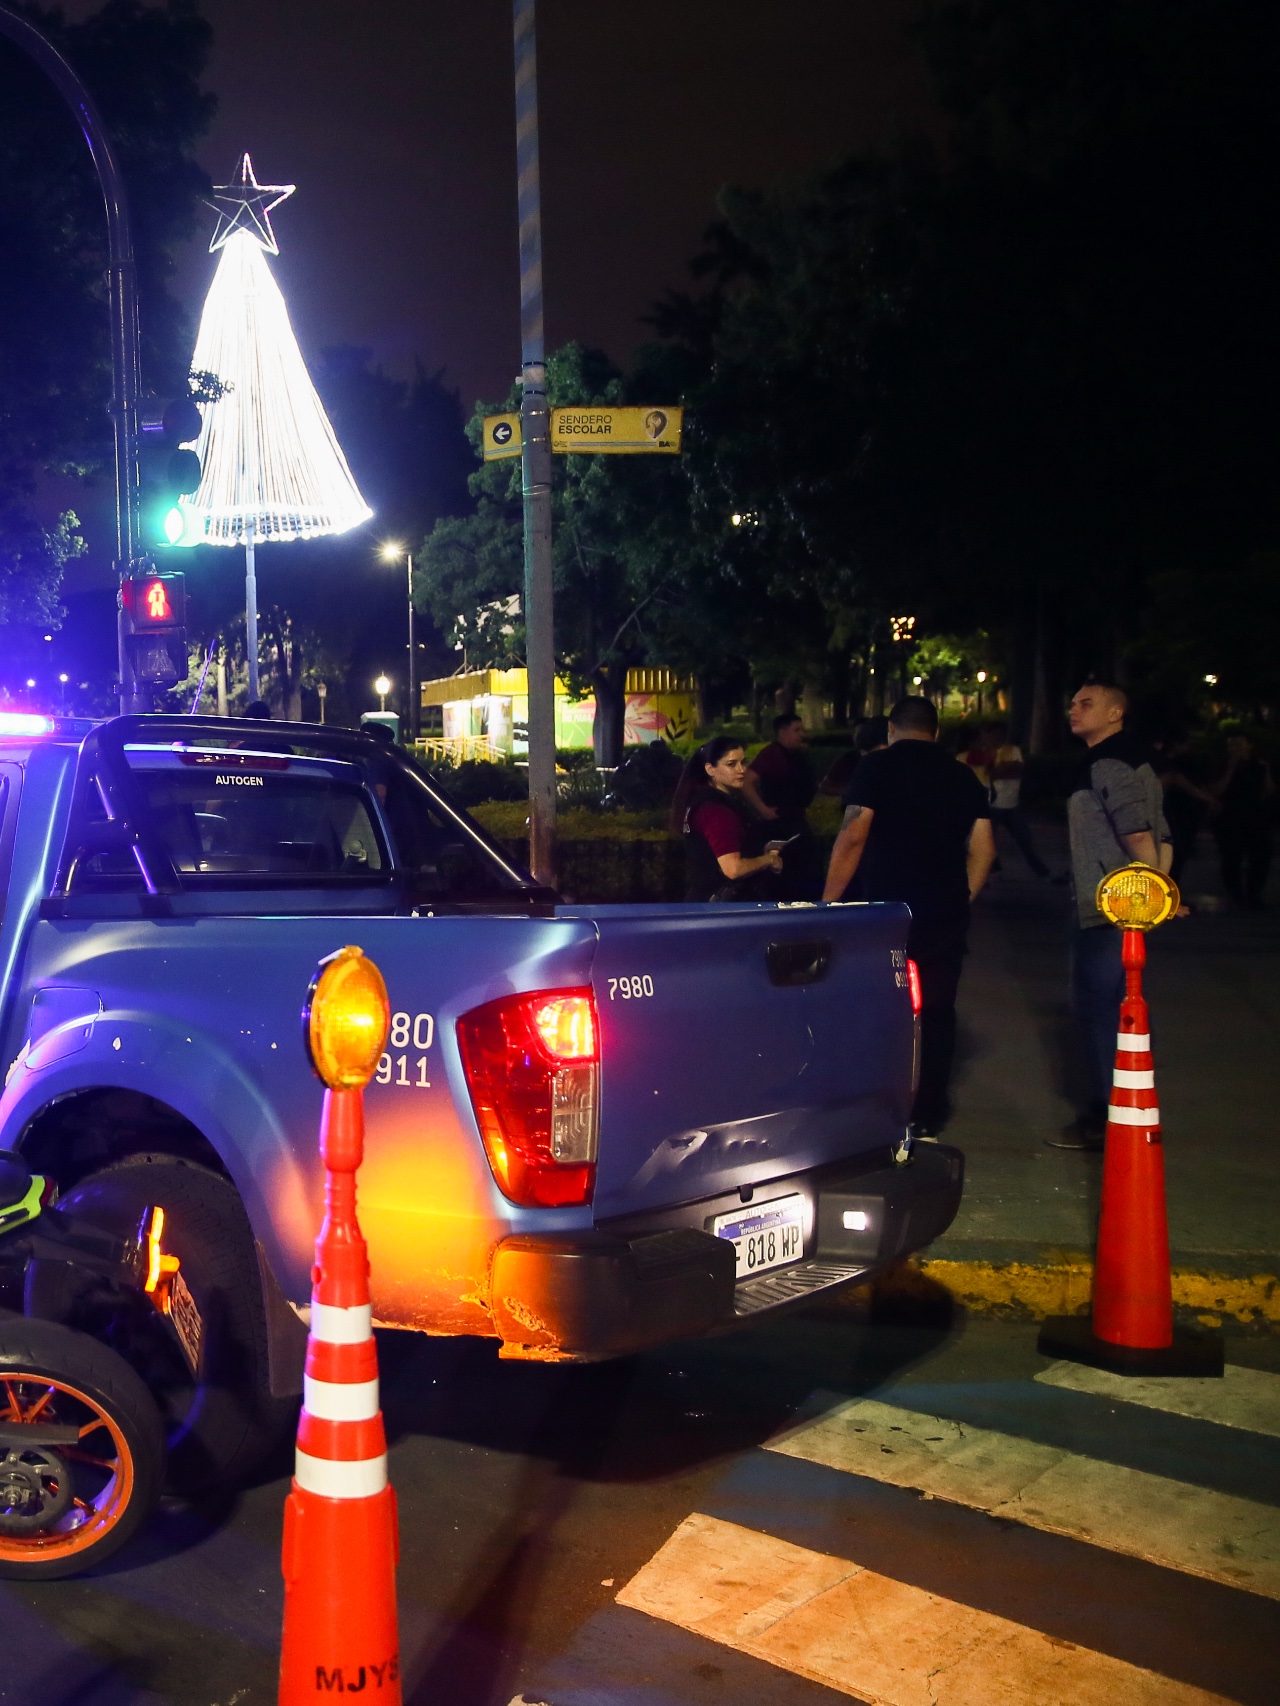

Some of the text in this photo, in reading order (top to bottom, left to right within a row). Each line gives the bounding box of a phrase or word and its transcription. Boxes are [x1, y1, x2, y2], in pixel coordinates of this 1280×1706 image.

[558, 415, 612, 425] SENDERO
[558, 425, 612, 434] ESCOLAR
[215, 775, 264, 786] AUTOGEN
[607, 974, 654, 1001] 7980
[390, 1011, 434, 1050] 80
[375, 1052, 431, 1088] 911
[747, 1231, 776, 1269] 818
[781, 1224, 800, 1258] WP
